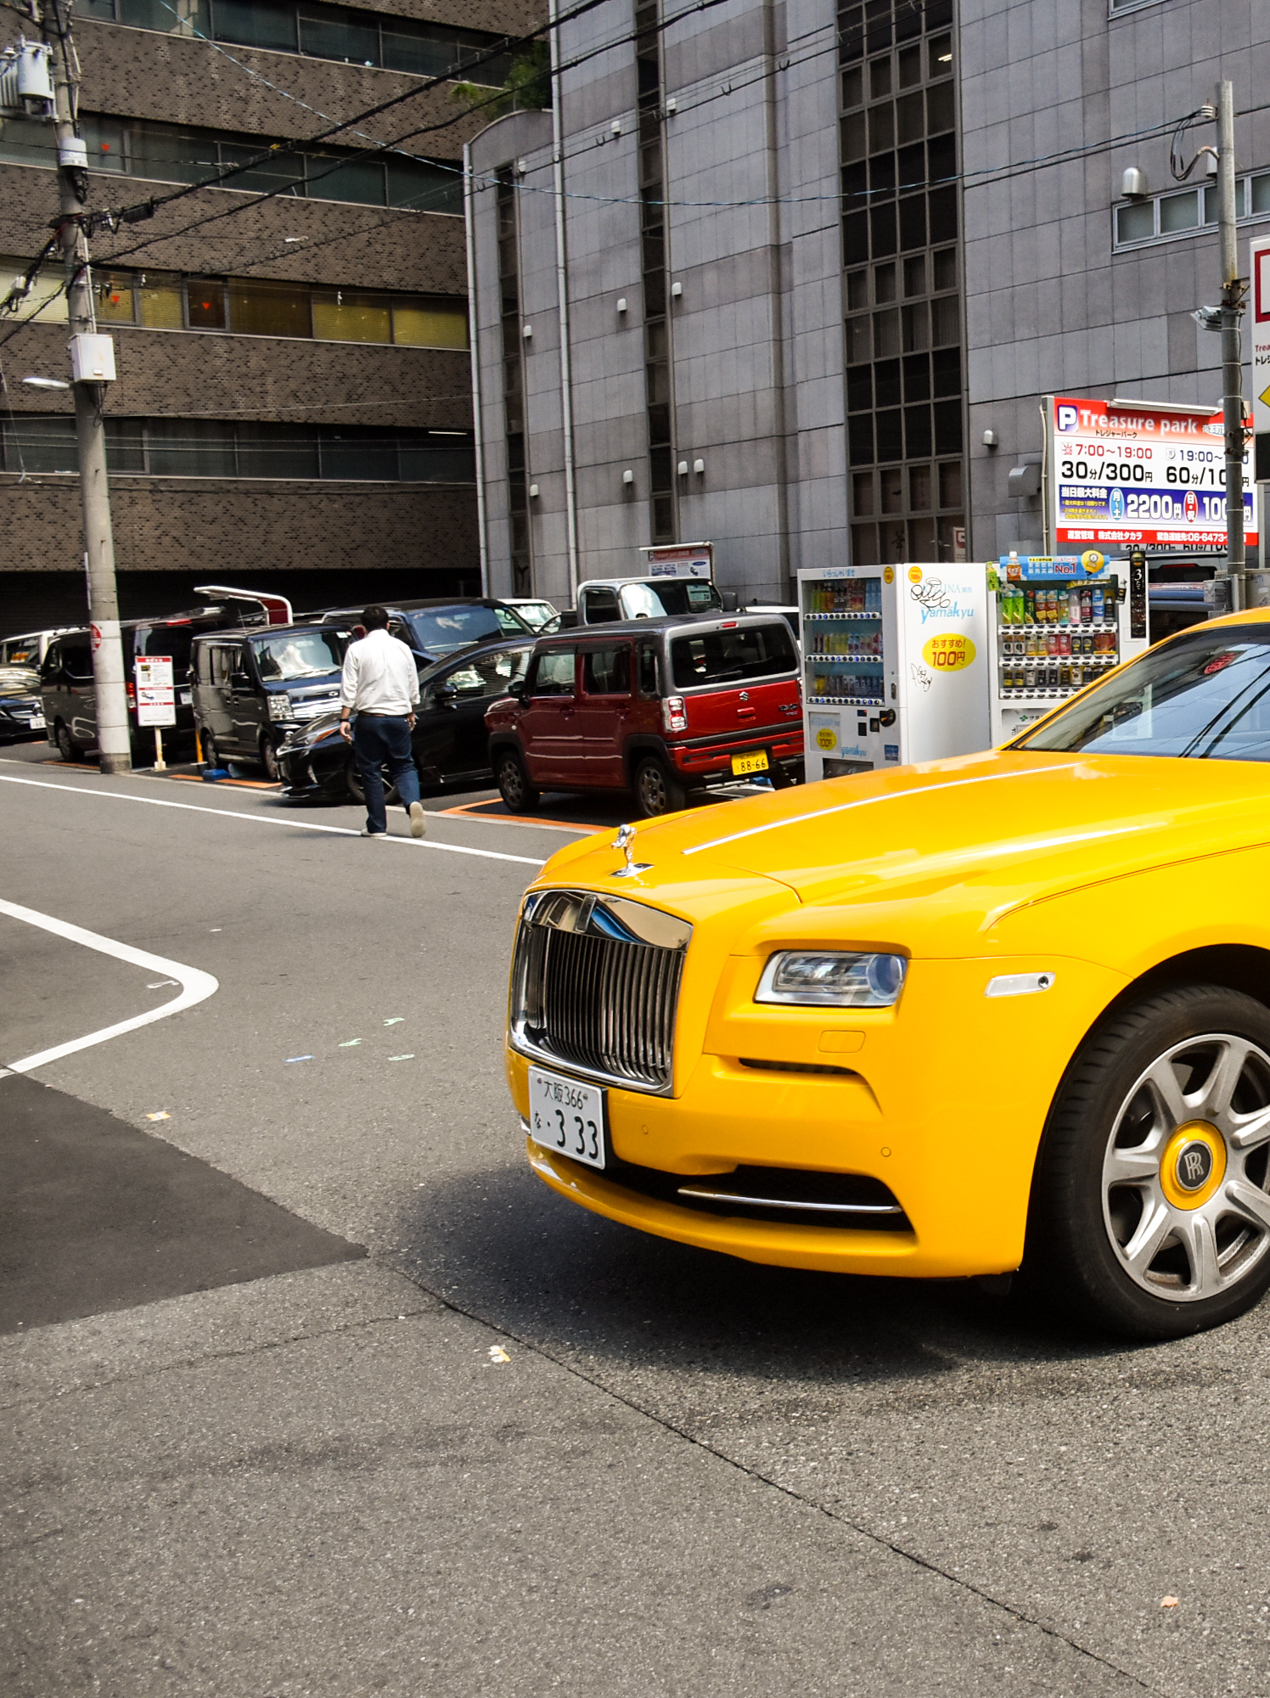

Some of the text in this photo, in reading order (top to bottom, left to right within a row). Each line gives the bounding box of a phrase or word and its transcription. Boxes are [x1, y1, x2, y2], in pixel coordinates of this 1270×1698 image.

[1080, 410, 1155, 430] Treasure
[1160, 418, 1198, 435] park
[1095, 430, 1137, 438] トレジャーパーク
[1061, 460, 1153, 482] 30分/300円
[1126, 494, 1182, 520] 2200円
[1098, 531, 1143, 541] 株式会社タカラ
[1054, 563, 1076, 574] No.1
[921, 602, 974, 624] yamakyu
[931, 638, 966, 649] おすすめ!
